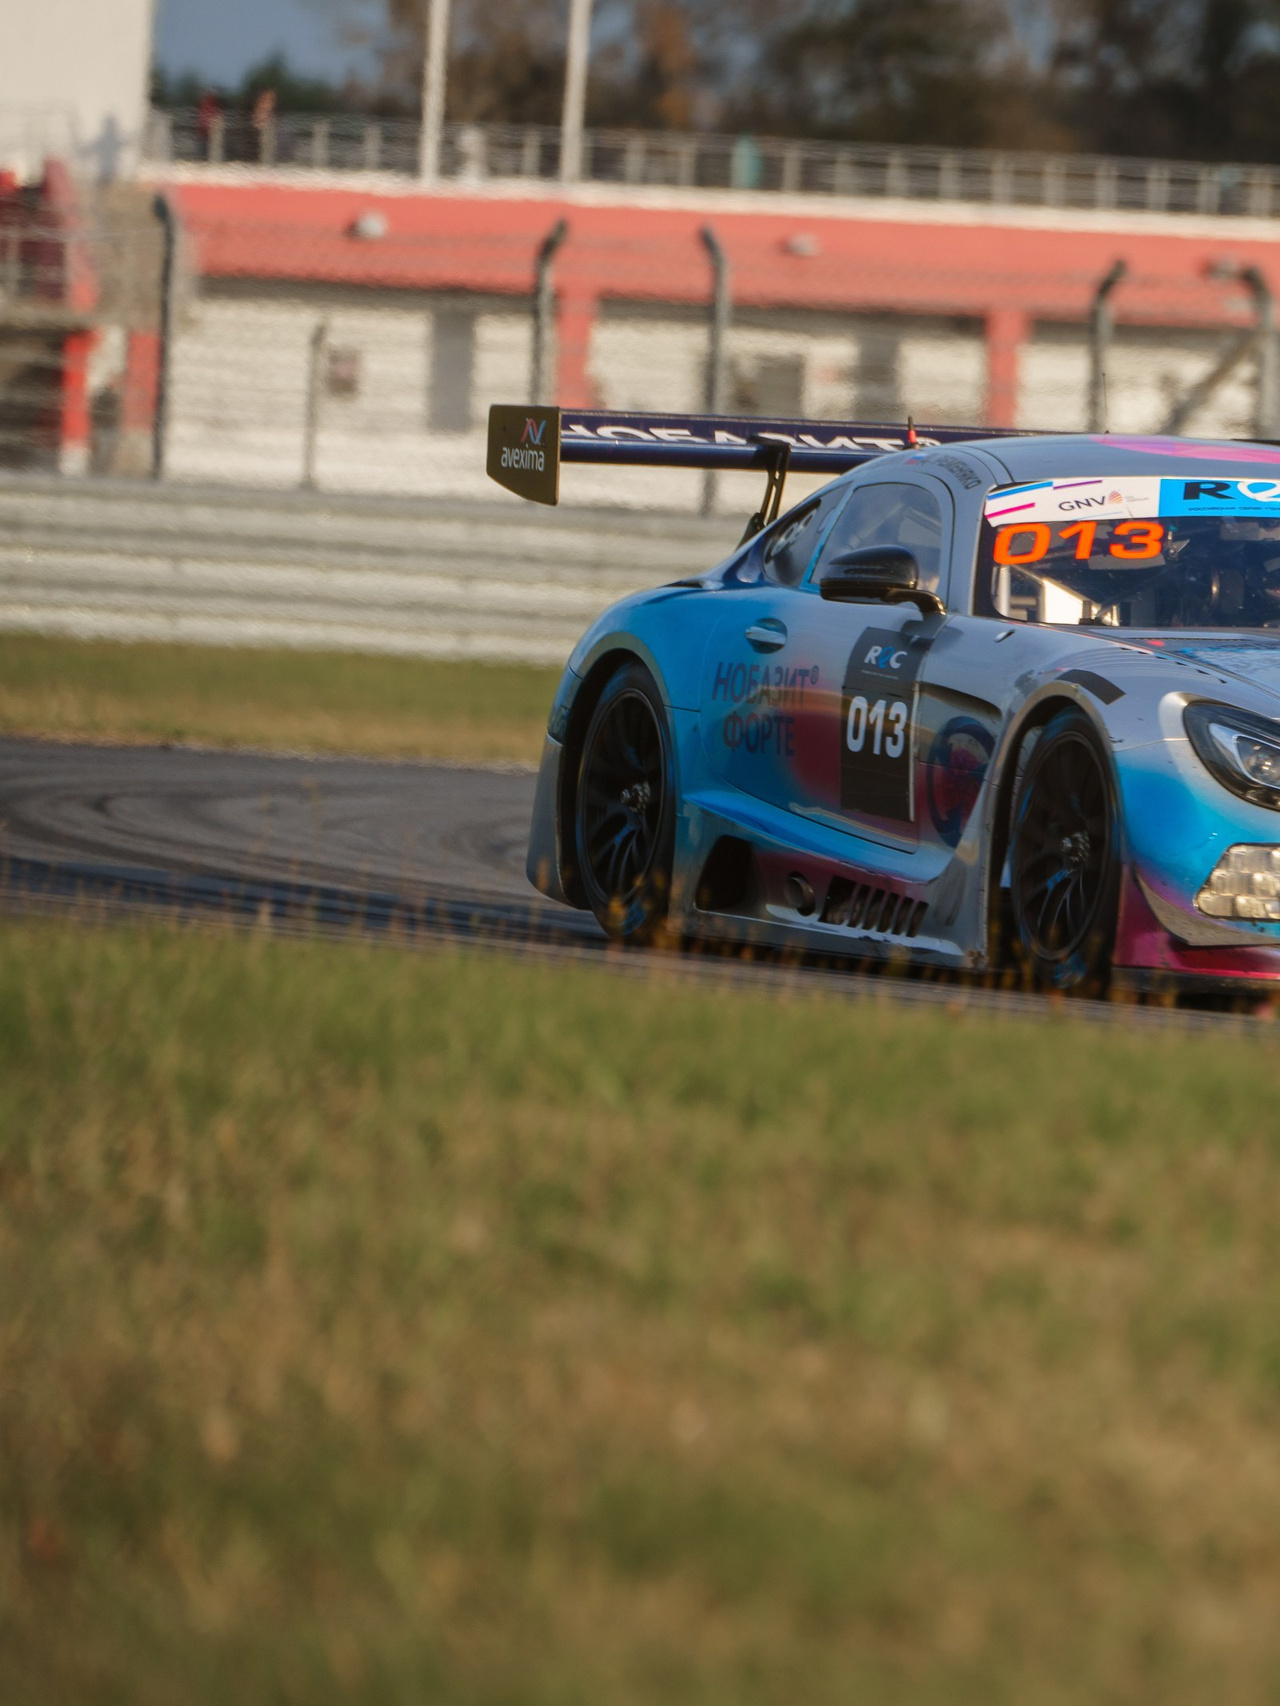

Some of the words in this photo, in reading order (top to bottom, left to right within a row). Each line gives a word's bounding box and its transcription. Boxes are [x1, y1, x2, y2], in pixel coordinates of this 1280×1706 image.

[501, 444, 545, 472] avexima
[1058, 496, 1106, 511] GNV
[993, 520, 1164, 565] 013
[723, 710, 795, 756] ФОРТЕ
[846, 695, 908, 758] 013
